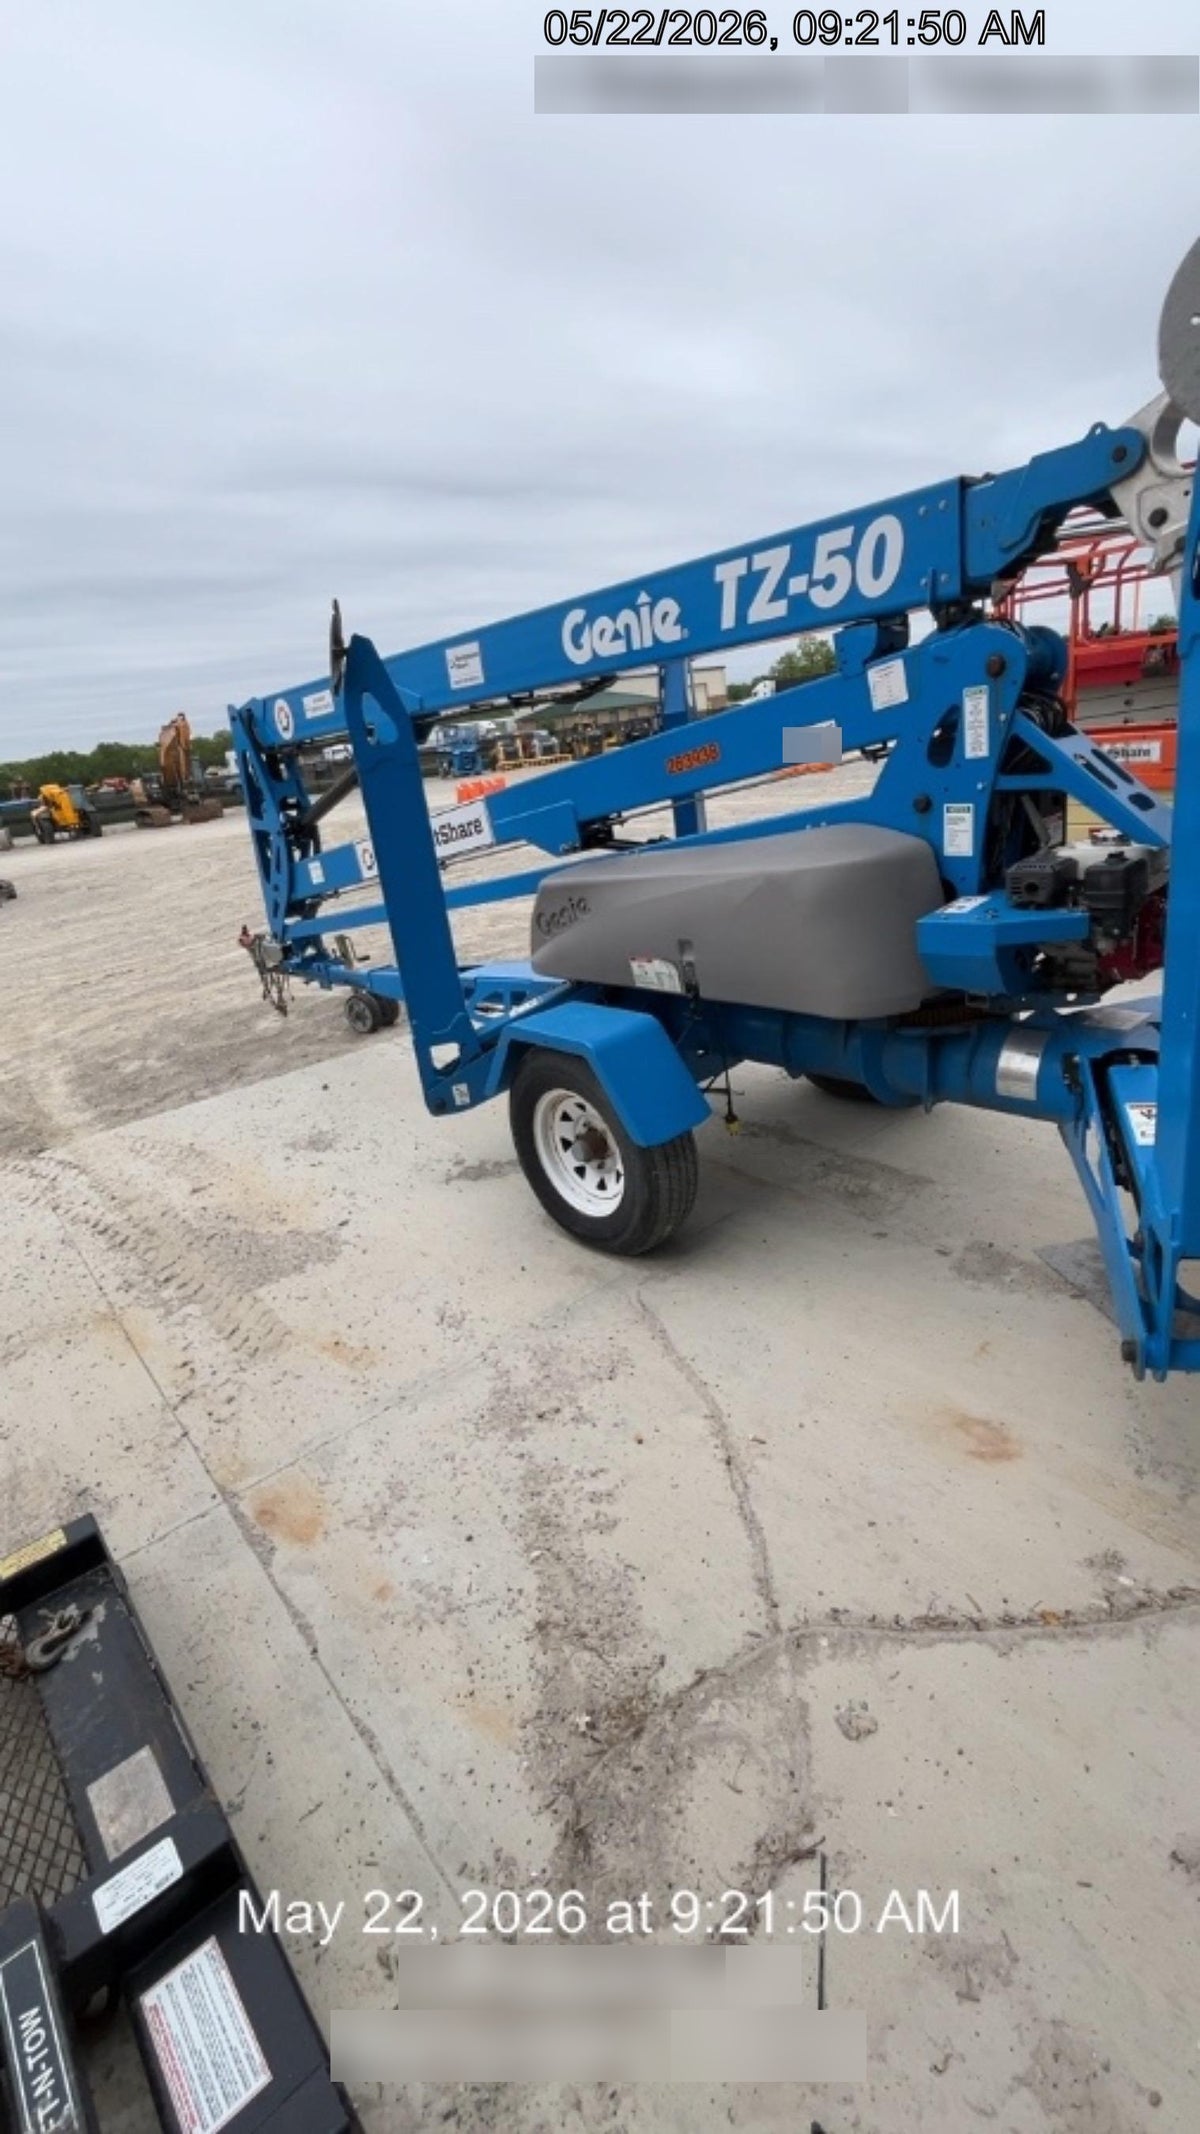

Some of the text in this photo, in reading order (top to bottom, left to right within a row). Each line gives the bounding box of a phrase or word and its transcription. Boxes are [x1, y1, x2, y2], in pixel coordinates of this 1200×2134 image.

[561, 513, 905, 665] Genie TZ-50
[535, 897, 588, 936] Genie
